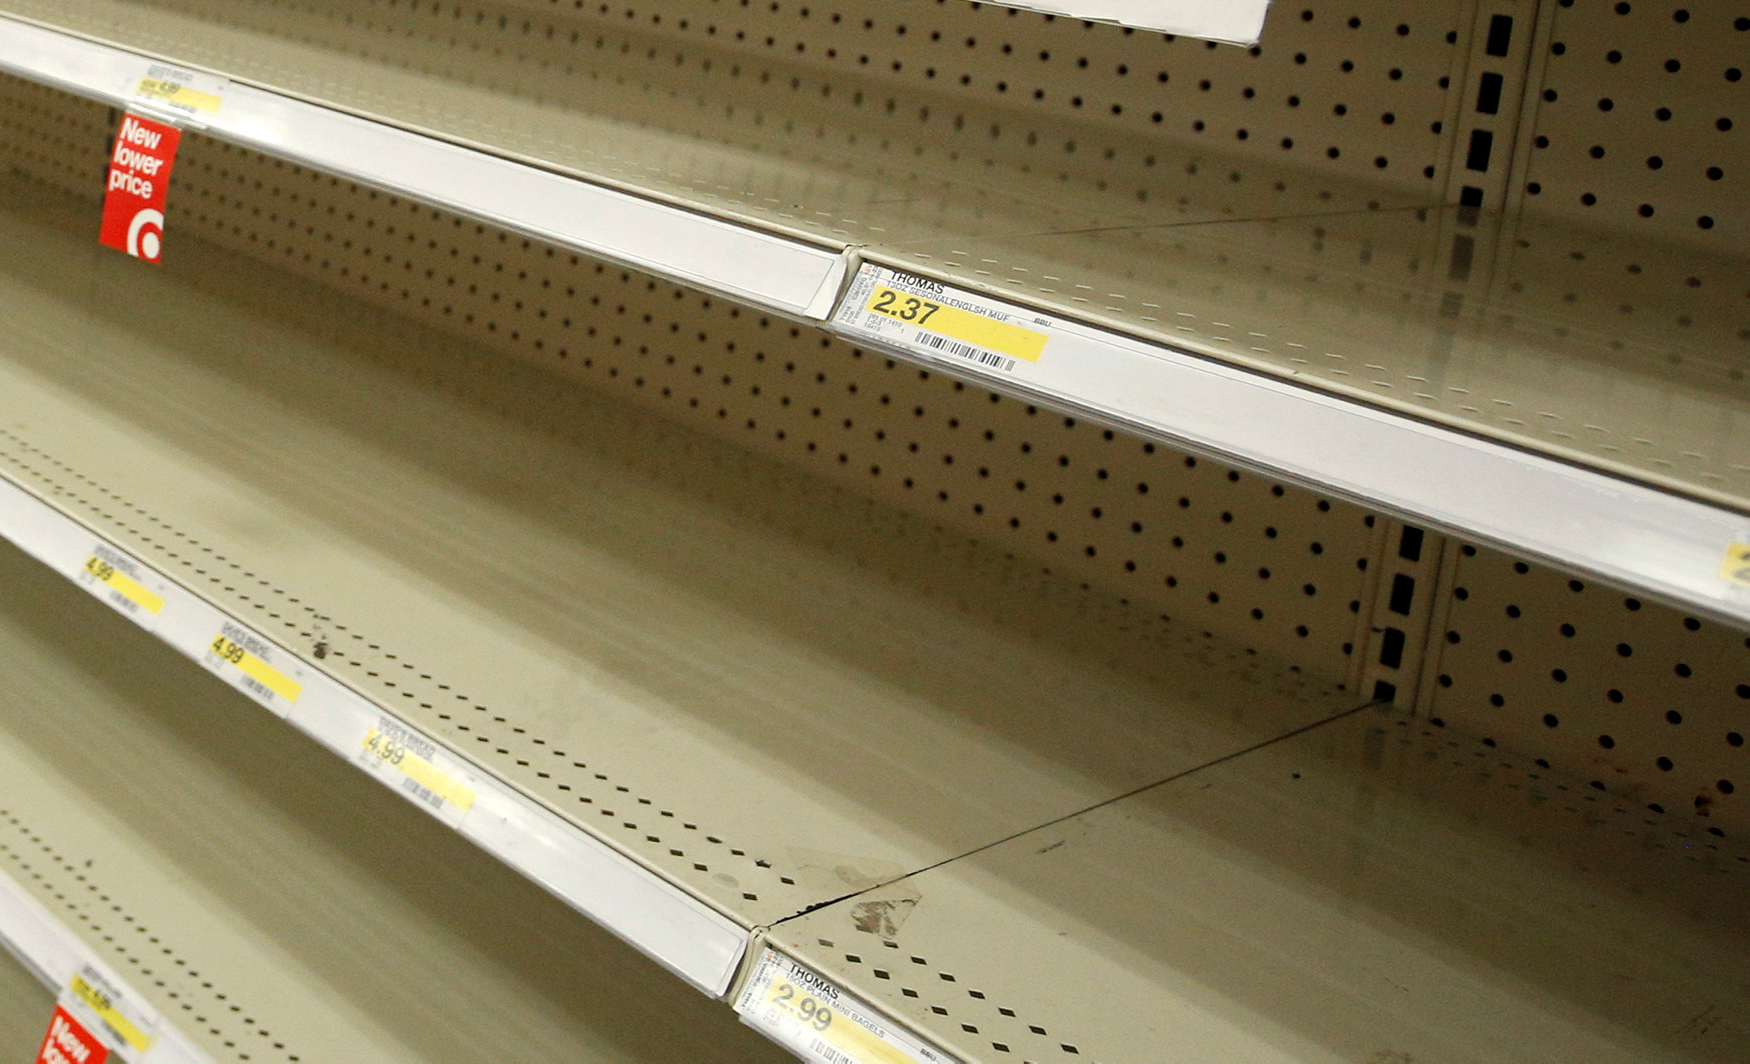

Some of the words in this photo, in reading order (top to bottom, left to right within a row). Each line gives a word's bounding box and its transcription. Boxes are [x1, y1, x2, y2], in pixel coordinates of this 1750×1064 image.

[120, 117, 162, 150] New
[113, 141, 165, 176] lower
[108, 168, 154, 200] price
[891, 271, 945, 294] THOMAS
[873, 290, 940, 325] 2.37
[987, 310, 1011, 322] MUF
[213, 636, 245, 665] 4.99
[367, 735, 405, 766] 4.99
[790, 962, 840, 1000] THOMAS
[772, 983, 832, 1032] 2.99
[806, 985, 830, 1005] PLAIN
[851, 1012, 886, 1038] BAGELS
